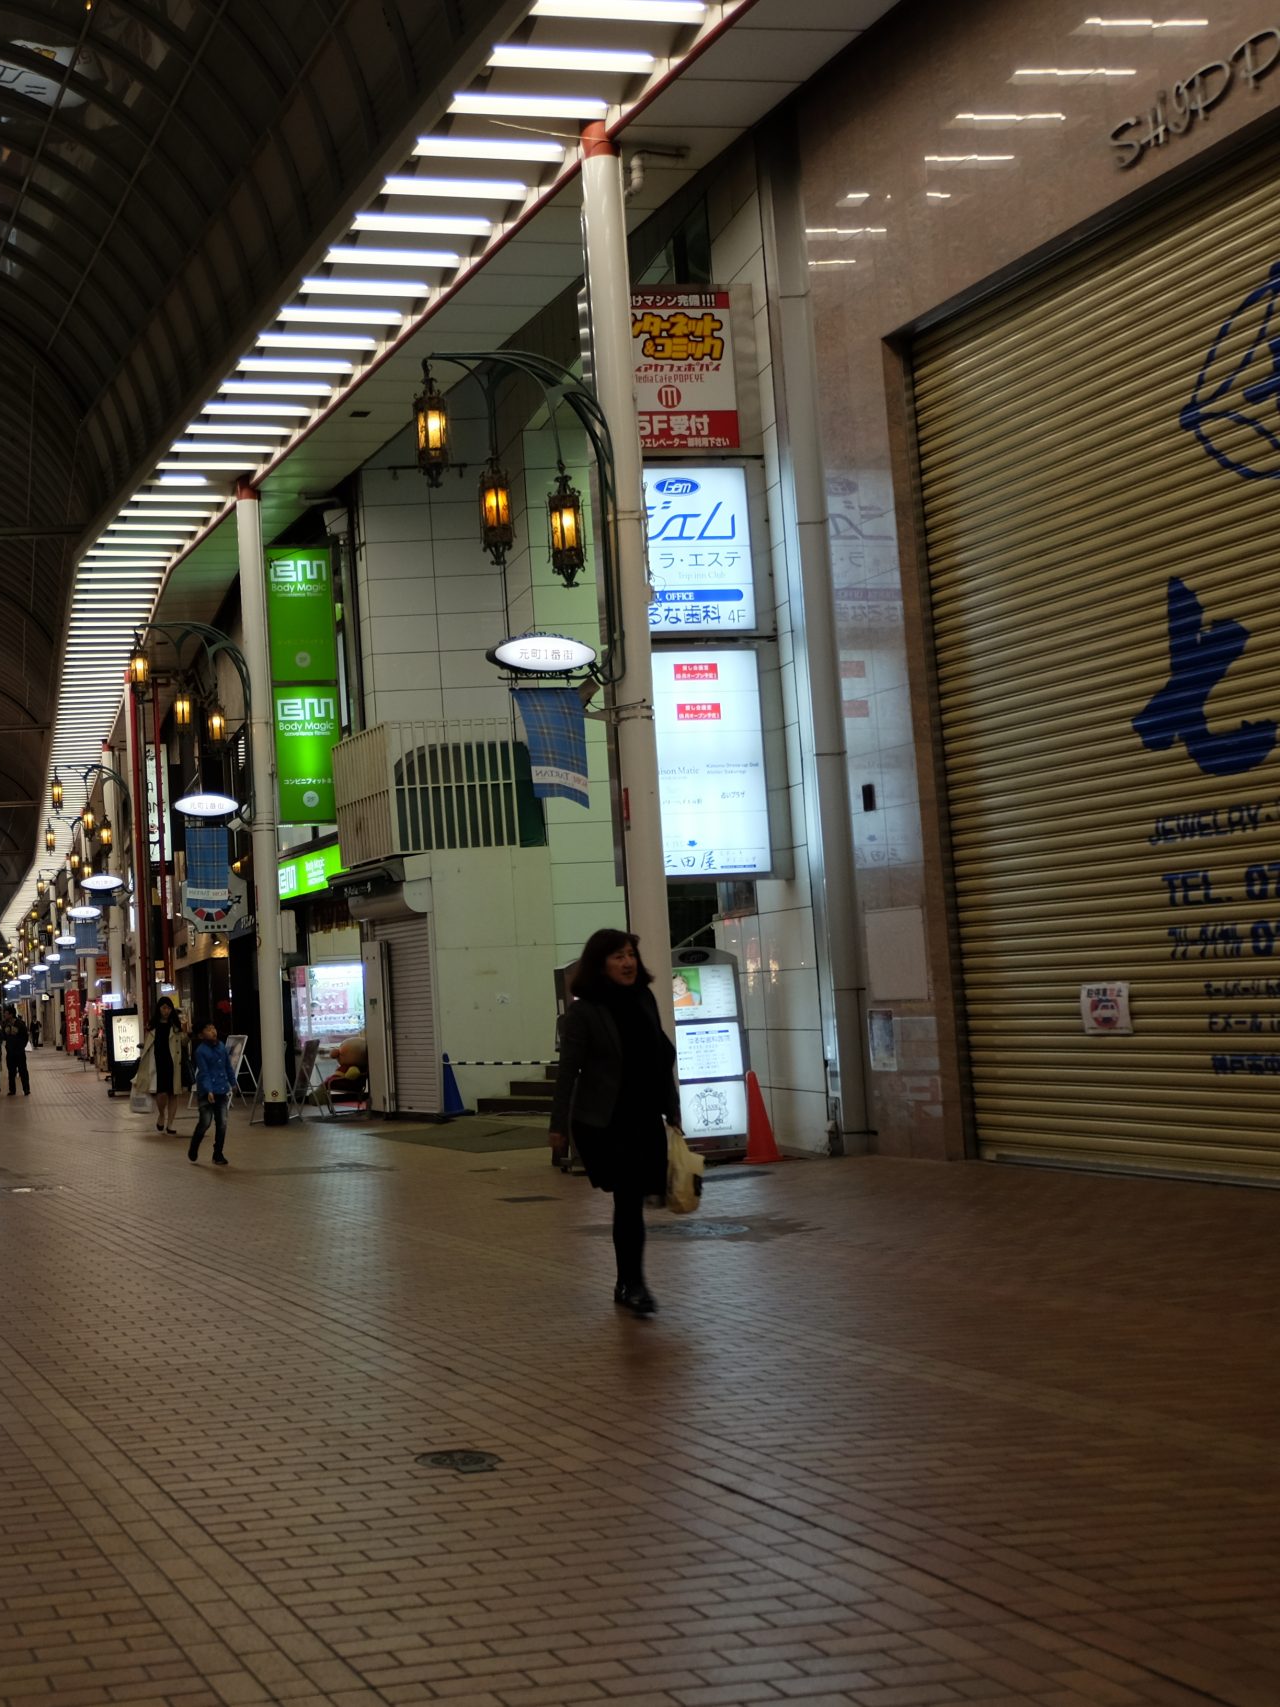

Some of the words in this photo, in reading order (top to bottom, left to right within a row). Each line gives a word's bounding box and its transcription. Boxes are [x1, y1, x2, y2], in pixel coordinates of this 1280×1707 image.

[631, 294, 715, 307] けマシン完備!!!
[673, 374, 705, 383] POPEYE
[665, 592, 695, 601] OFFICE
[279, 722, 302, 731] Body
[305, 722, 334, 731] Magic
